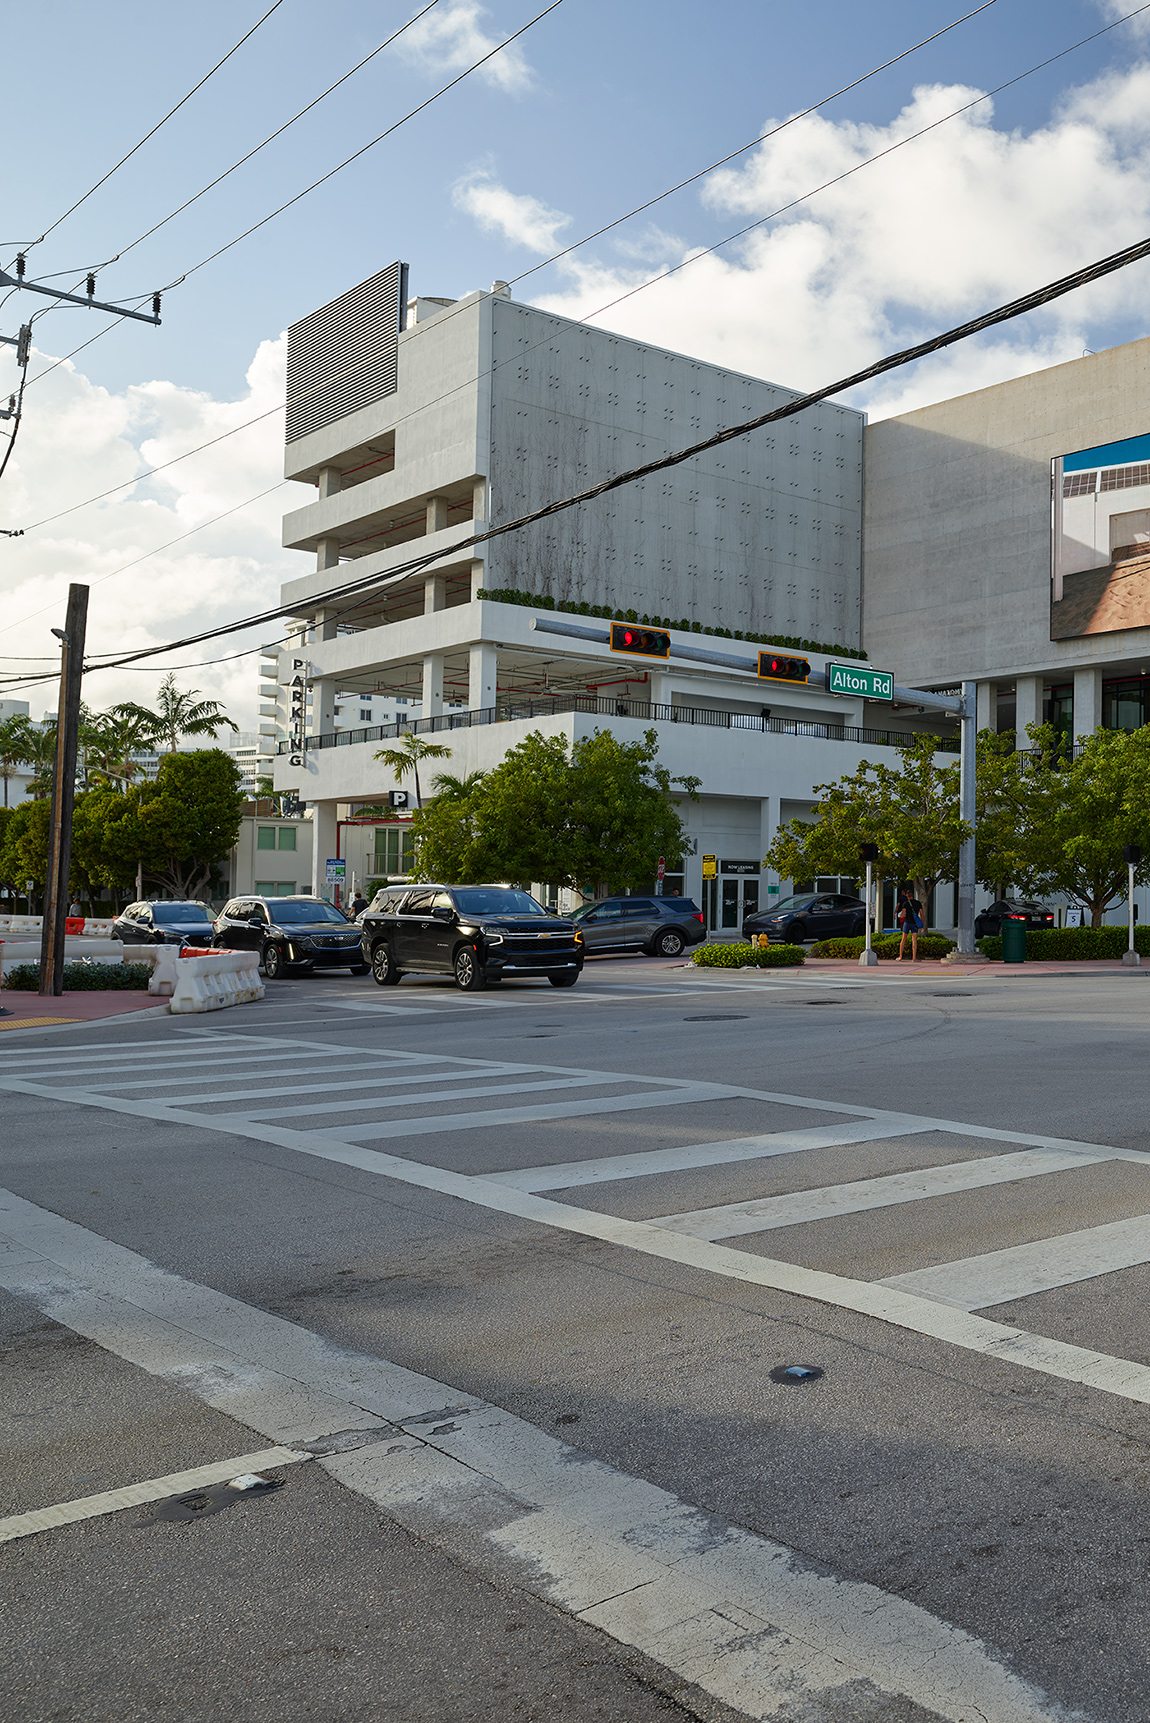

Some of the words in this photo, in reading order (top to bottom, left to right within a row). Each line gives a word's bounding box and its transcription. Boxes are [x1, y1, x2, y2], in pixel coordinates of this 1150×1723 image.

[833, 672, 868, 691] Alton
[873, 678, 890, 694] Rd
[288, 659, 303, 766] PARKING
[393, 792, 406, 805] P
